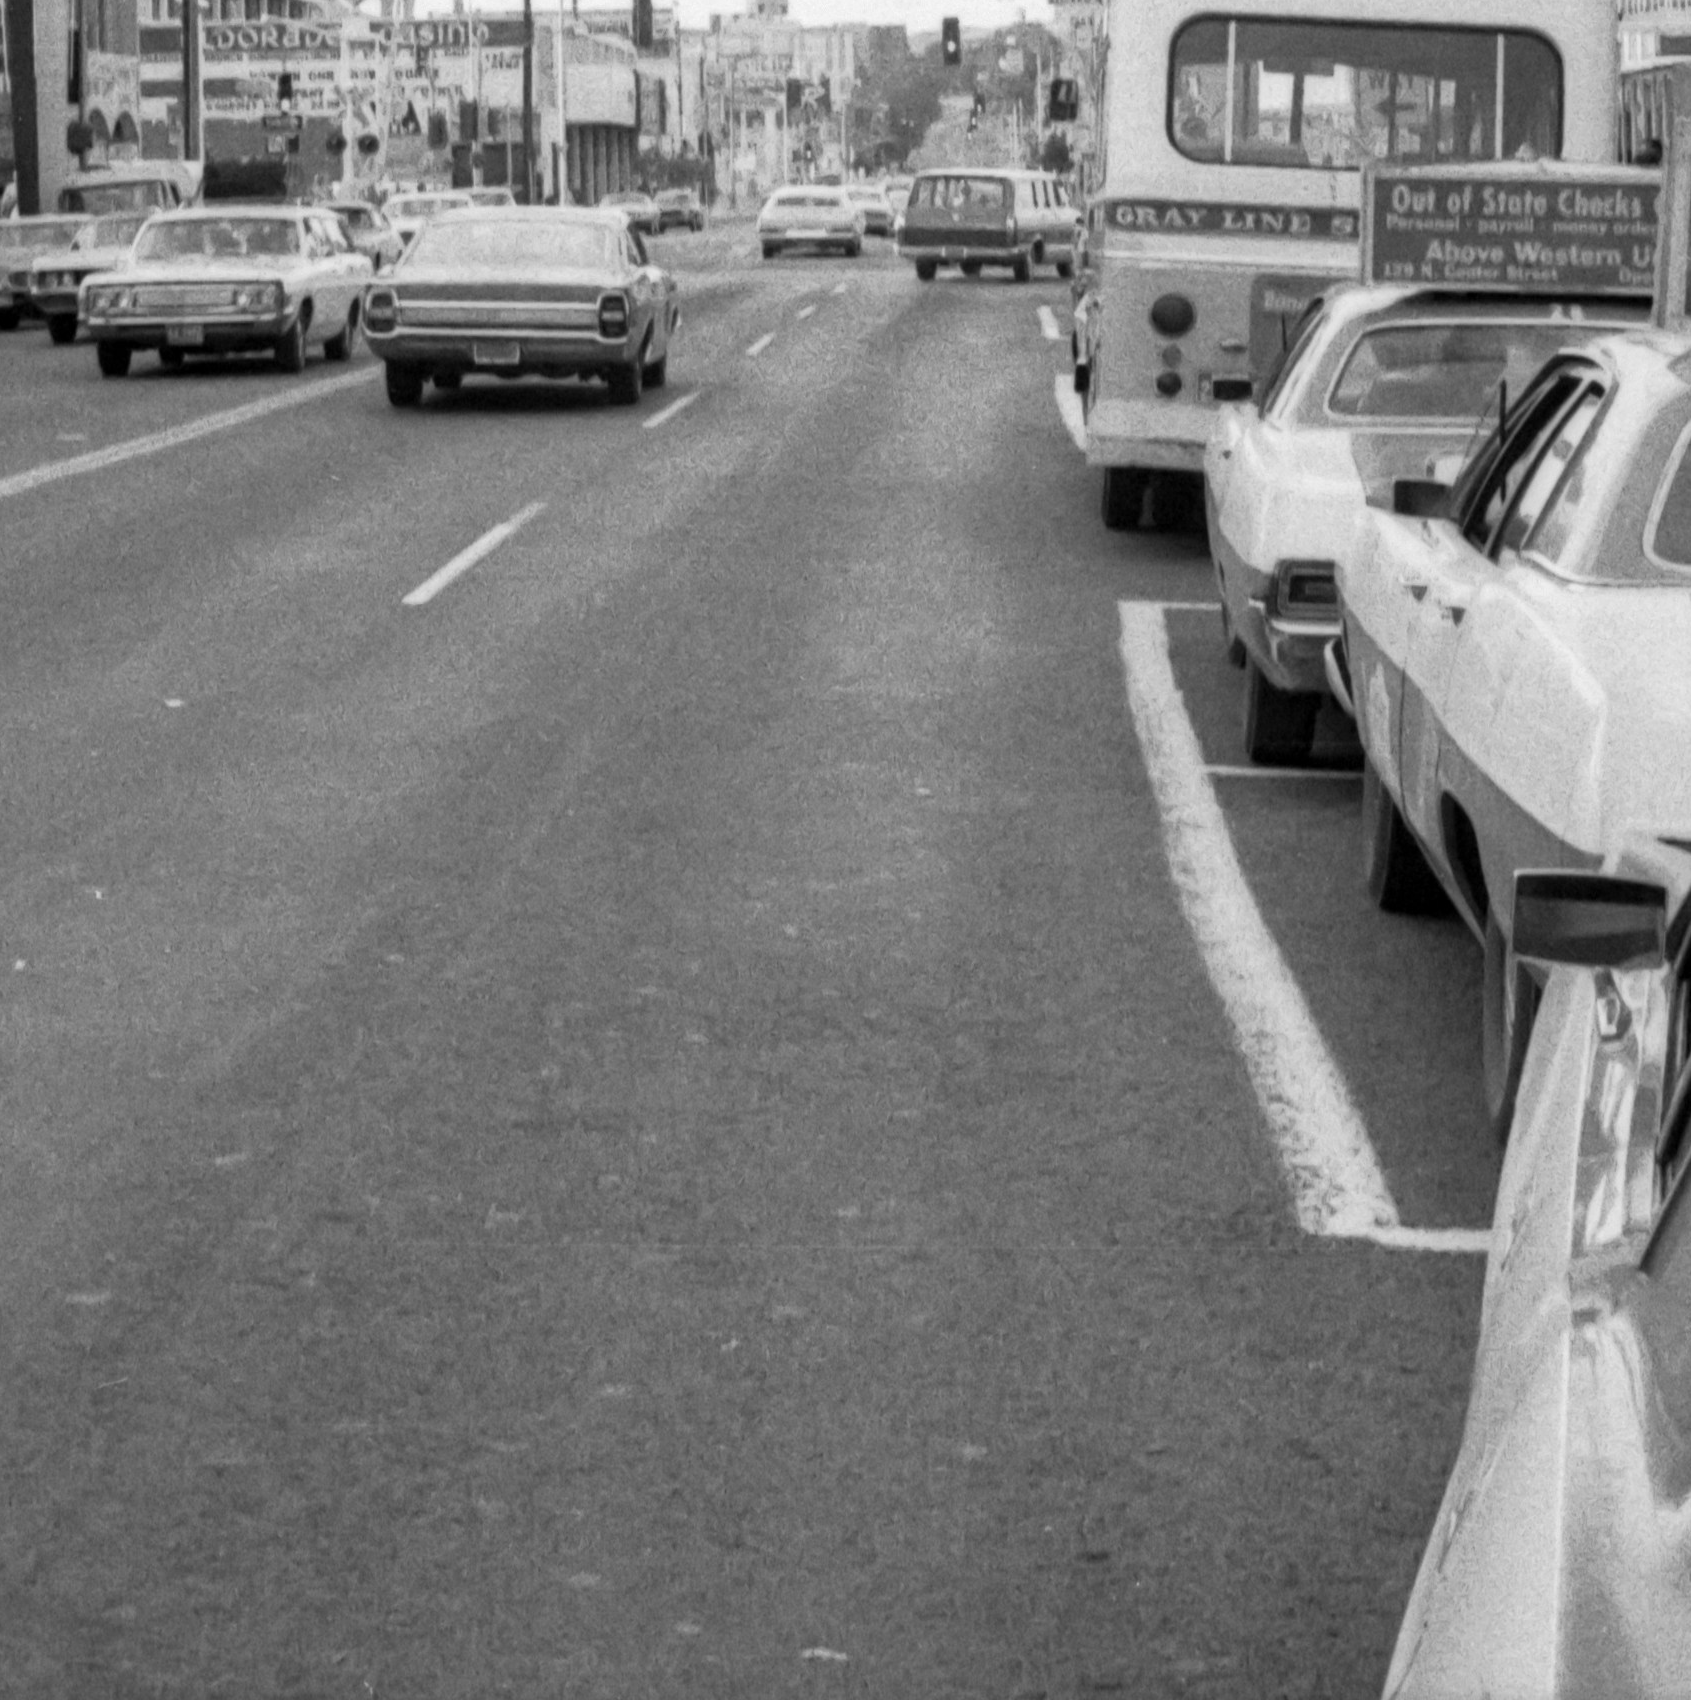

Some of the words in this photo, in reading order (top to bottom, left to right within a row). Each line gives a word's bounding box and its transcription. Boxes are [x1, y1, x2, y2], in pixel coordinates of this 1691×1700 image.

[1116, 204, 1208, 226] GRAY
[1392, 184, 1436, 214] Out
[1446, 185, 1473, 214] of
[1482, 186, 1548, 216] State
[1557, 188, 1642, 218] Checks
[1426, 240, 1505, 265] Above
[1514, 242, 1622, 268] Western
